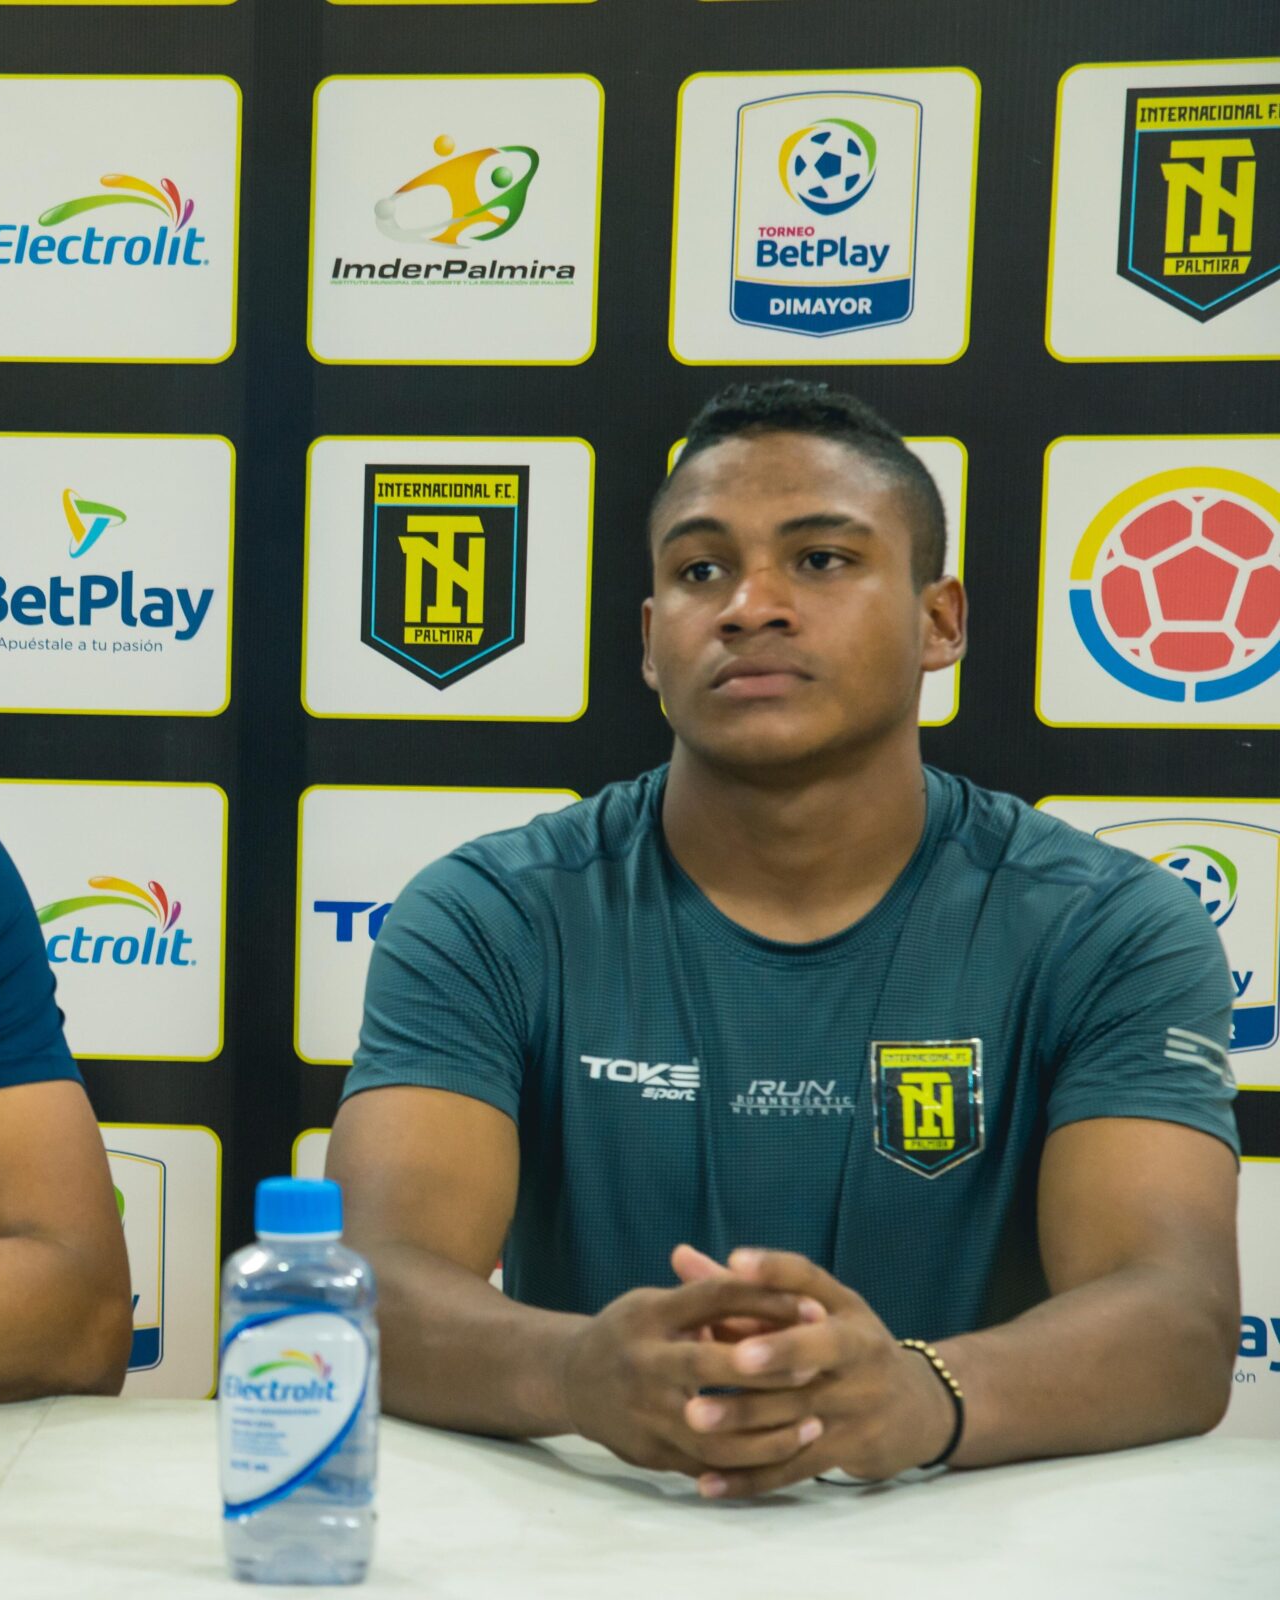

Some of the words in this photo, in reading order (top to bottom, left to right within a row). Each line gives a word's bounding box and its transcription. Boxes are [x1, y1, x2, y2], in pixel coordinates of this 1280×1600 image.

[1140, 104, 1263, 122] INTERNACIONAL
[758, 226, 815, 237] TORNEO
[756, 236, 890, 273] BetPlay
[331, 257, 576, 279] ImderPalmira
[1175, 259, 1240, 273] PALMIRA
[769, 297, 873, 315] DIMAYOR
[378, 483, 490, 498] INTERNACIONAL
[414, 629, 473, 642] PALMIRA
[78, 640, 87, 651] a
[92, 639, 107, 651] tu
[112, 638, 163, 653] pasión
[46, 926, 193, 966] ctrolit
[580, 1055, 700, 1088] TOKE
[641, 1087, 696, 1101] sport
[748, 1080, 836, 1096] RUN
[224, 1374, 335, 1402] Electrolit
